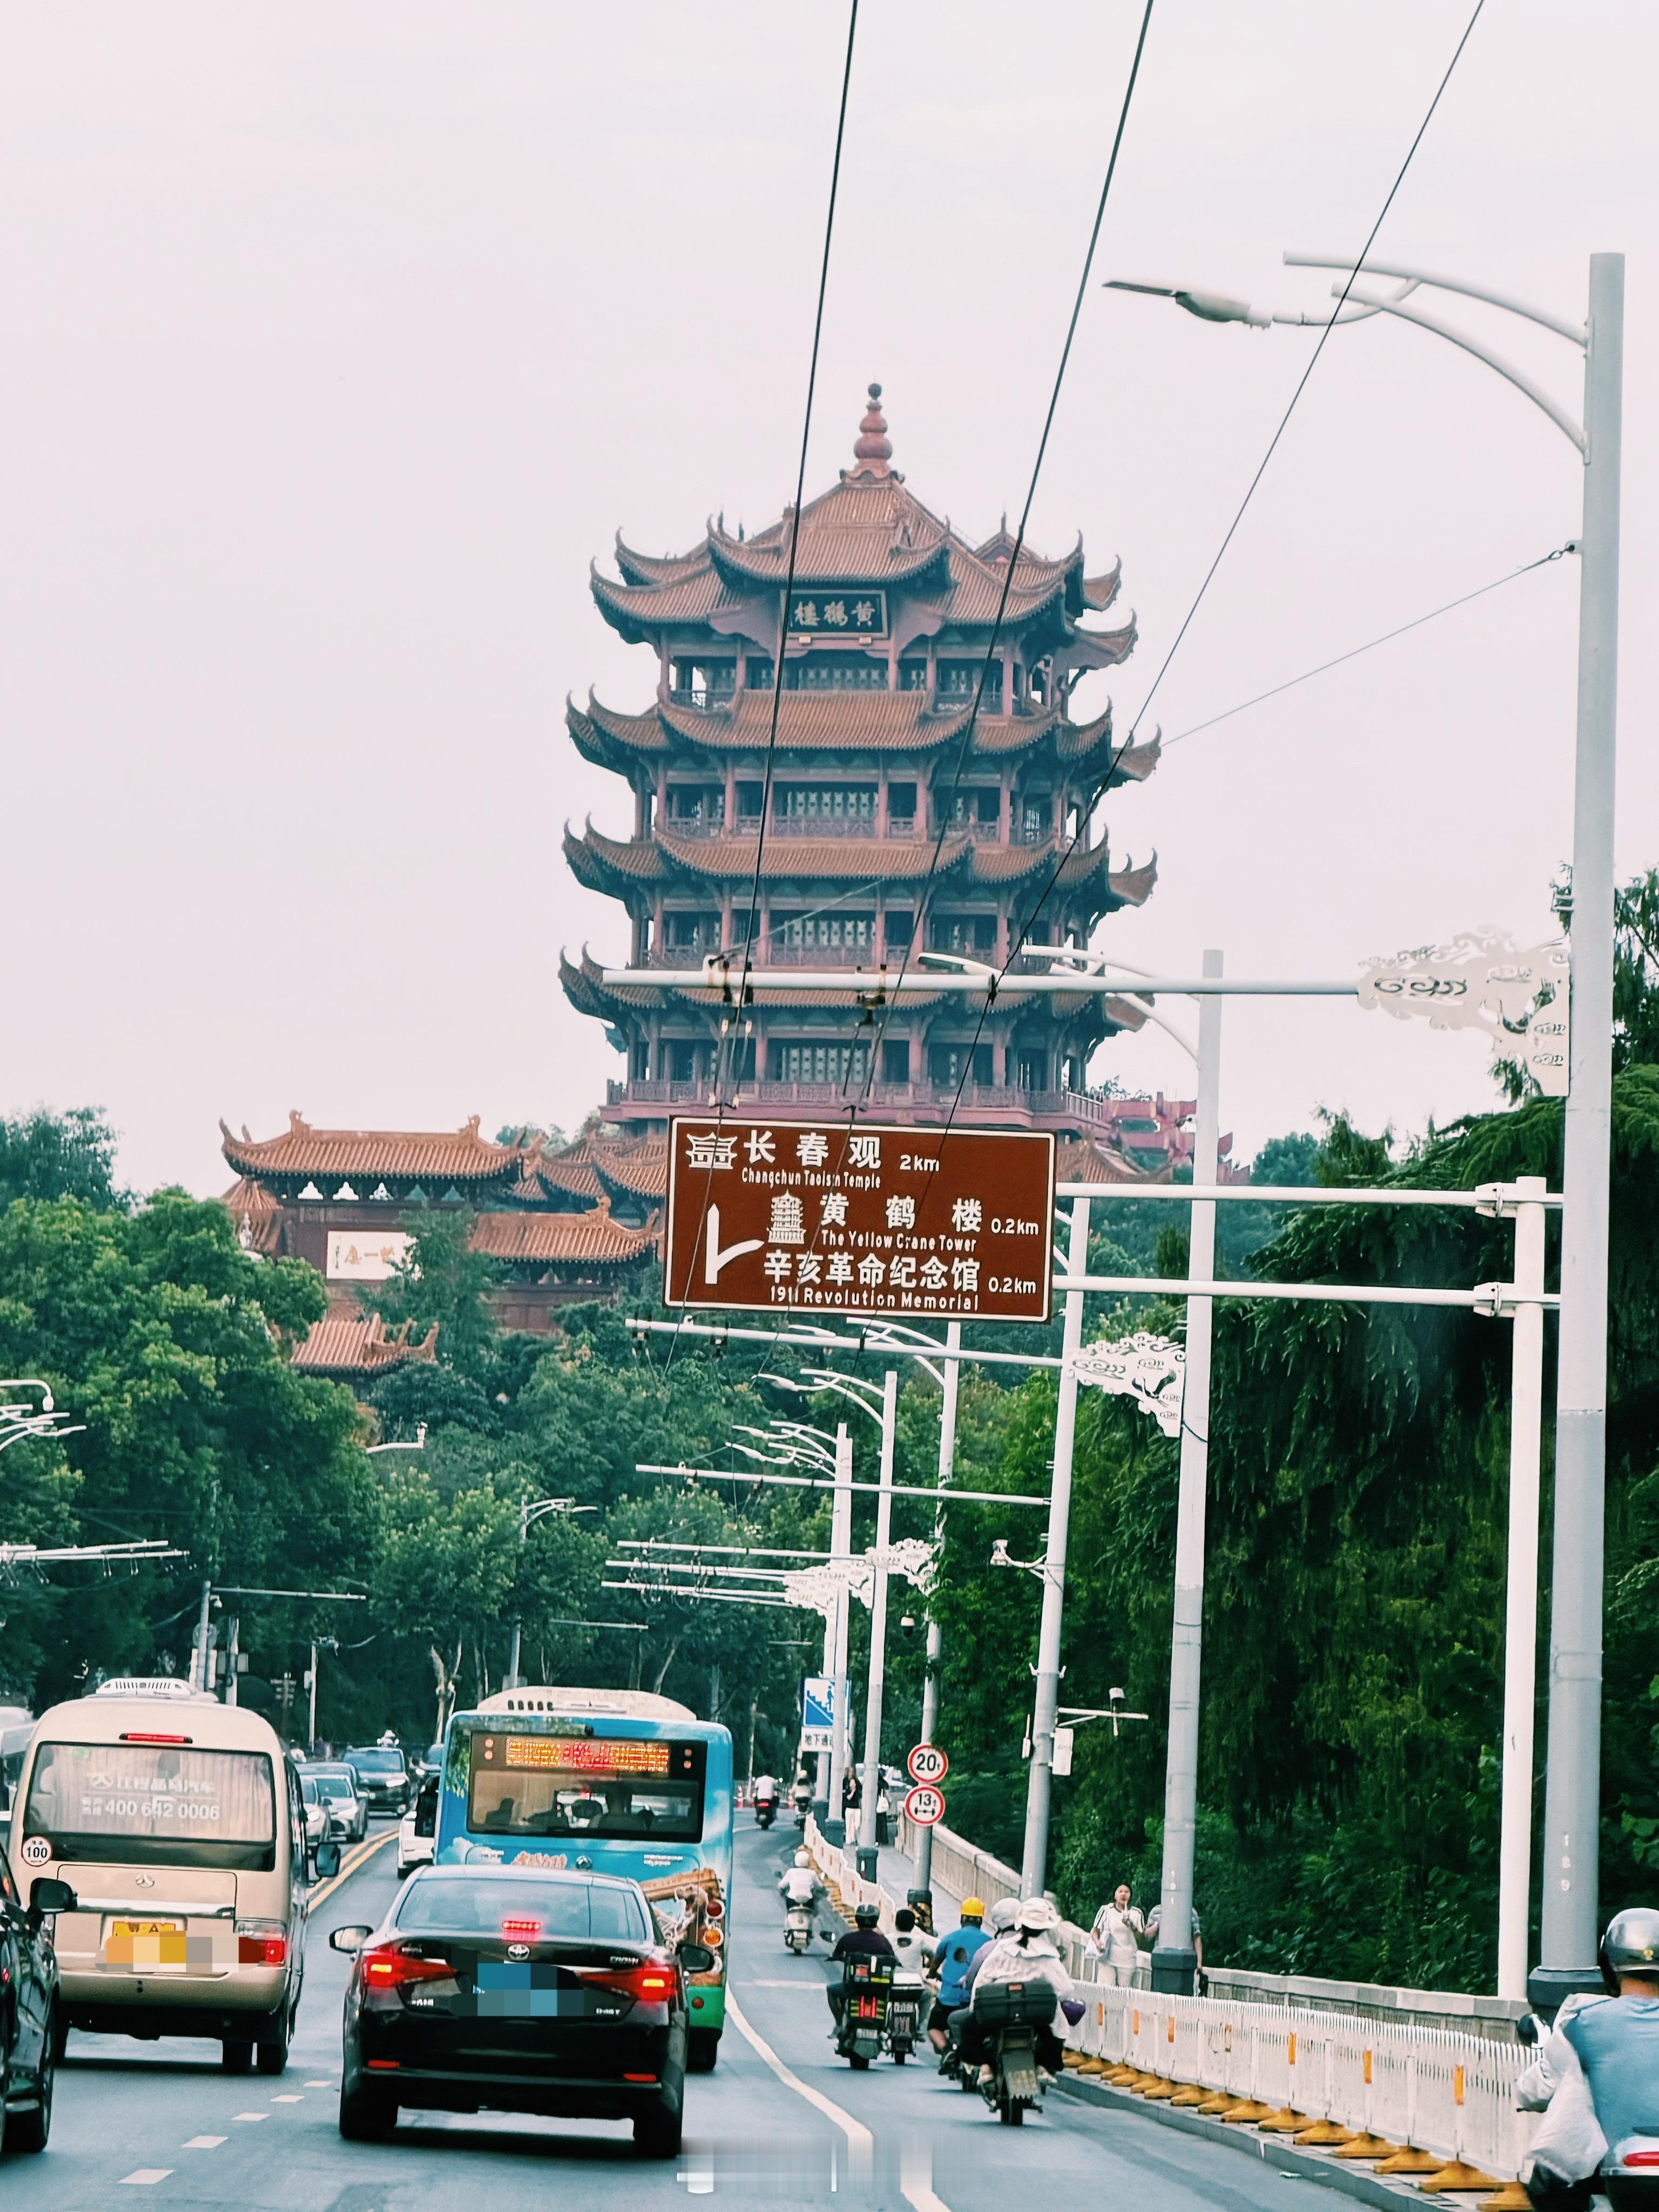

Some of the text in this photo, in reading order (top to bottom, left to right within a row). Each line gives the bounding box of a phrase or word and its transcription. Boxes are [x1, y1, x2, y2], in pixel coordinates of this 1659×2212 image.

[744, 1129, 939, 1171] 长春观 2km
[741, 1167, 801, 1189] Changchun
[844, 1172, 881, 1191] Temple
[820, 1192, 1039, 1235] 黄鹤楼 0.2km
[821, 1229, 977, 1252] The Yellow Crane Tower
[764, 1249, 1036, 1294] 辛亥革命纪念馆 0.2km
[770, 1286, 979, 1311] 1911 Revolution Memorial
[106, 1798, 138, 1816] 400
[178, 1803, 220, 1820] 0006
[26, 1846, 48, 1858] 100
